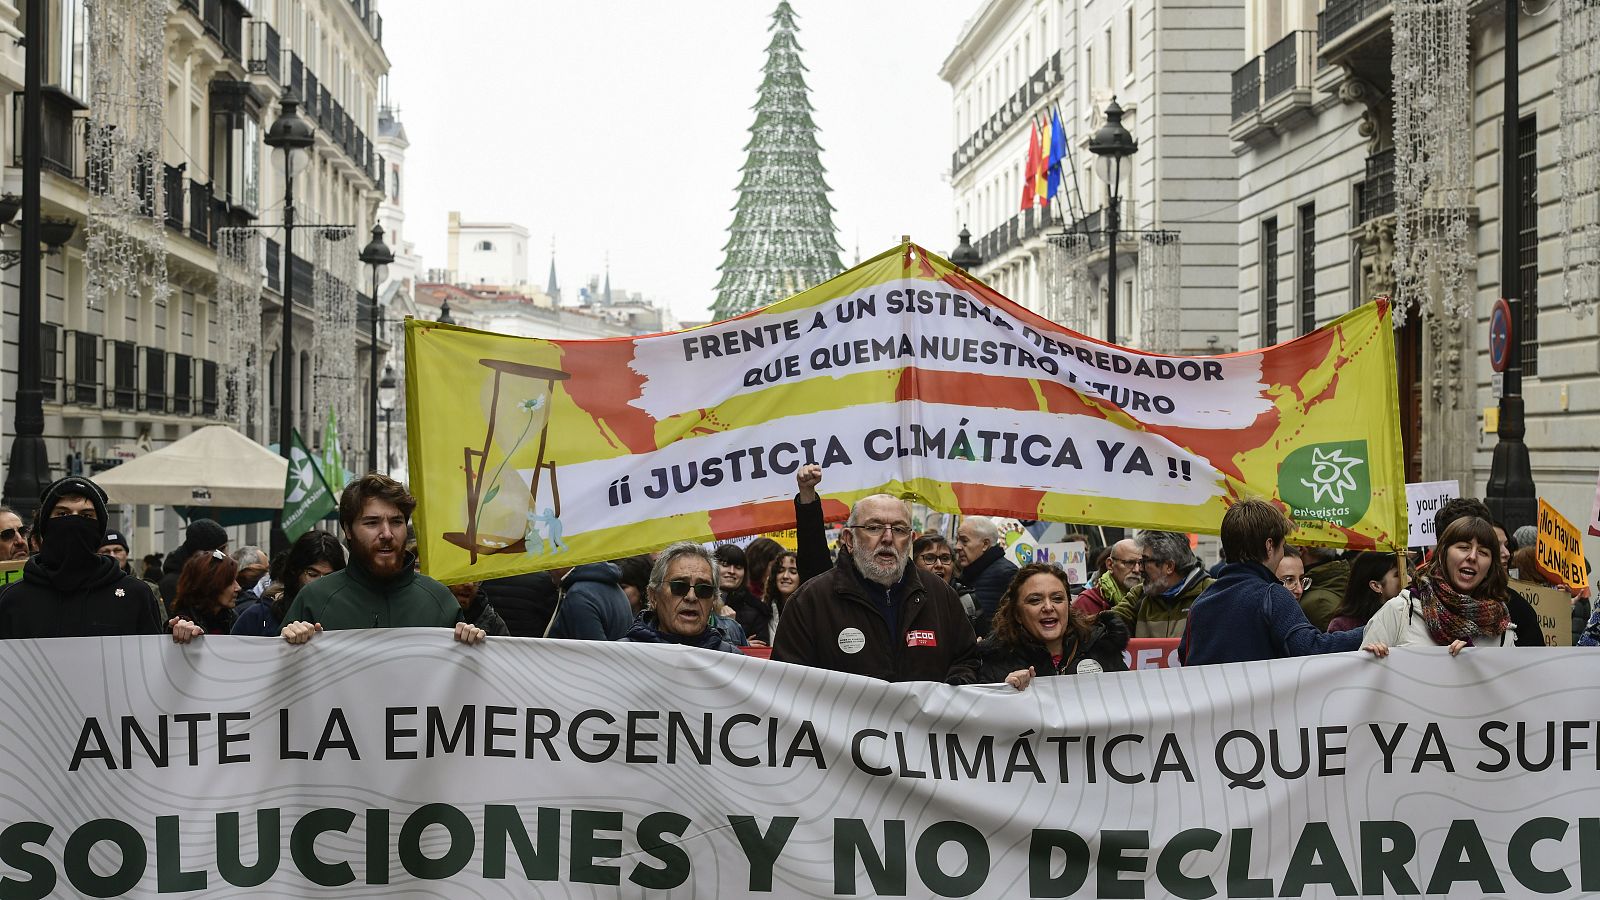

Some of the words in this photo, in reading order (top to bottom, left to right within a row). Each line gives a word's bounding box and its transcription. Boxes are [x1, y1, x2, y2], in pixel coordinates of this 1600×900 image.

[682, 319, 800, 361] FRENTE
[807, 311, 828, 333] A
[836, 294, 876, 324] UN
[743, 354, 801, 388] QUE
[810, 333, 916, 371] QUEMA
[920, 335, 1059, 376] NUESTRO
[1068, 370, 1176, 415] TURO
[643, 434, 853, 500] JUSTICIA
[863, 417, 1083, 470] CLIMÁTICA
[1096, 439, 1154, 476] YA
[1167, 456, 1192, 482] !!
[1416, 498, 1438, 516] your
[1554, 518, 1569, 552] hay
[1569, 535, 1581, 556] un
[1063, 551, 1085, 564] HAY
[68, 711, 252, 772] ANTE
[279, 707, 362, 761] LA
[384, 704, 828, 770] EMERGENCIA
[850, 728, 1196, 785] CLIMÁTICA
[1214, 724, 1349, 790] QUE
[1368, 722, 1456, 774] YA
[1475, 720, 1600, 773] SUF
[0, 802, 693, 900] SOLUCIONES
[725, 814, 800, 892] Y
[833, 817, 991, 898] NO
[1028, 816, 1600, 900] DECLARACI
